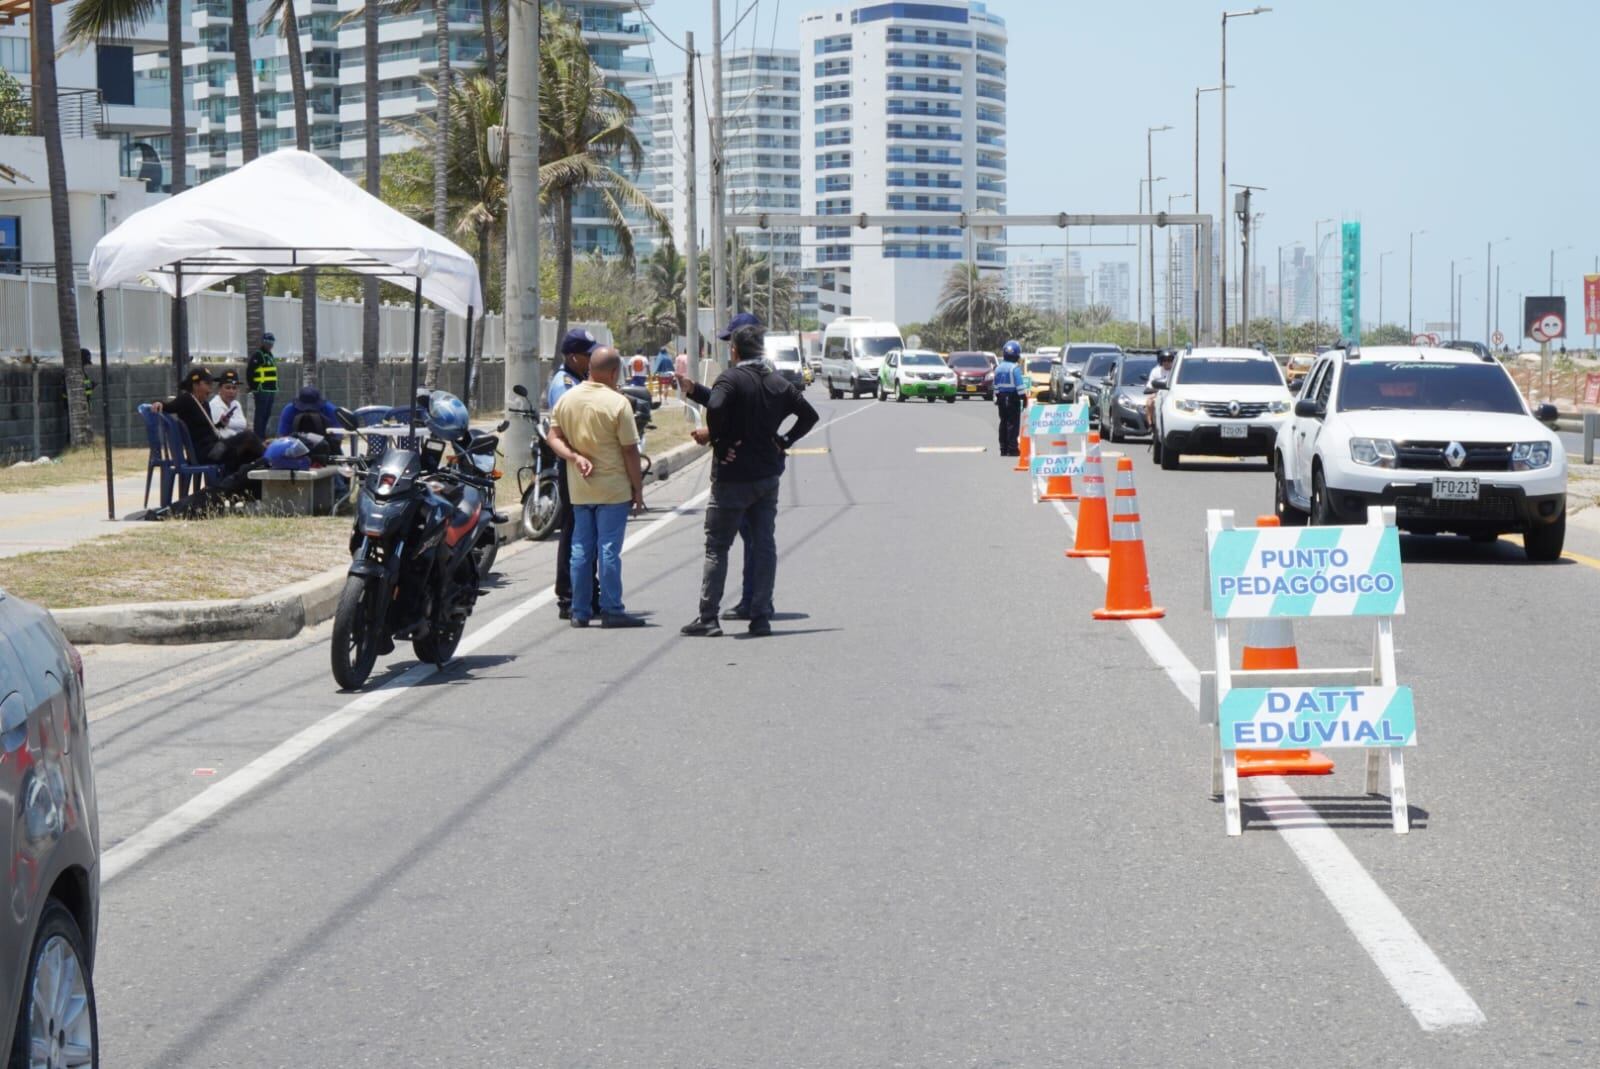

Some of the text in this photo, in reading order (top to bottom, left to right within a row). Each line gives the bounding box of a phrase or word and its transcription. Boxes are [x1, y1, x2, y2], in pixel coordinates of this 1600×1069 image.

[1044, 411, 1073, 419] PUNTO
[1046, 457, 1075, 465] DATT
[1261, 548, 1349, 569] PUNTO
[1220, 571, 1394, 596] PEDAGÓGICO
[1267, 691, 1365, 714] DATT
[1234, 719, 1404, 744] EDUVIAL
